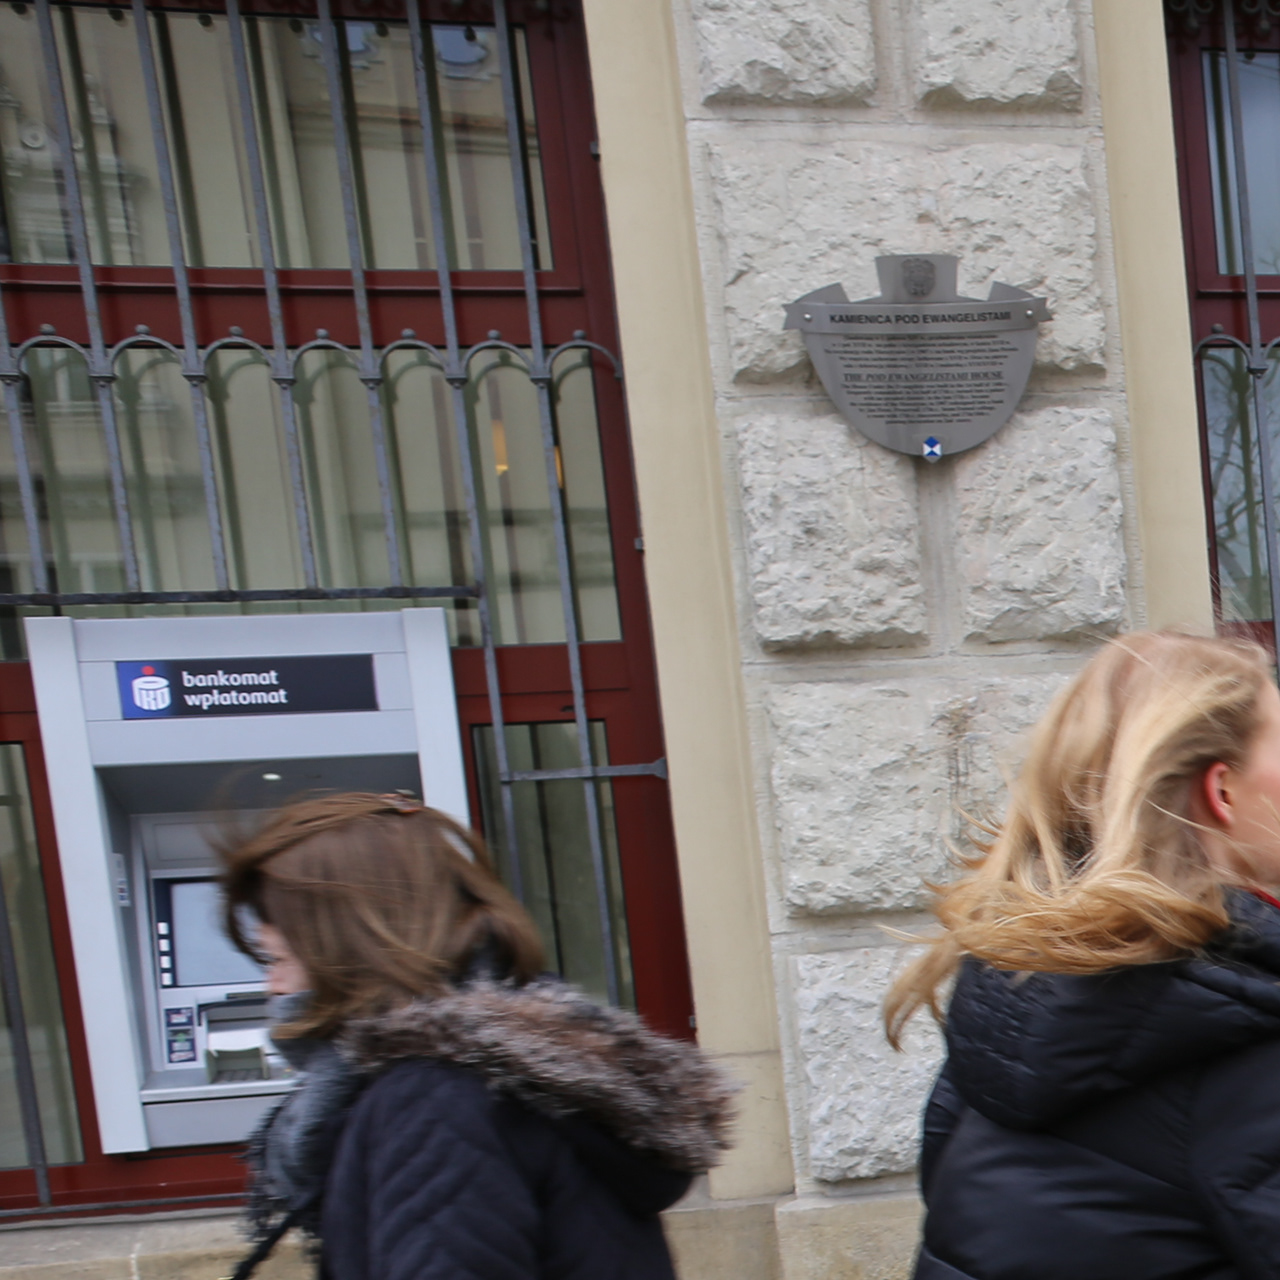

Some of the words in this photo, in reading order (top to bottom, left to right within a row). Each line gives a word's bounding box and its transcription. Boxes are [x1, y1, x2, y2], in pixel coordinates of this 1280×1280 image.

[829, 314, 893, 324] KAMIENICA
[895, 314, 920, 324] POD
[923, 311, 1012, 323] EWANGELISTAMI
[181, 669, 279, 687] bankomat
[183, 688, 288, 710] wpłatomat
